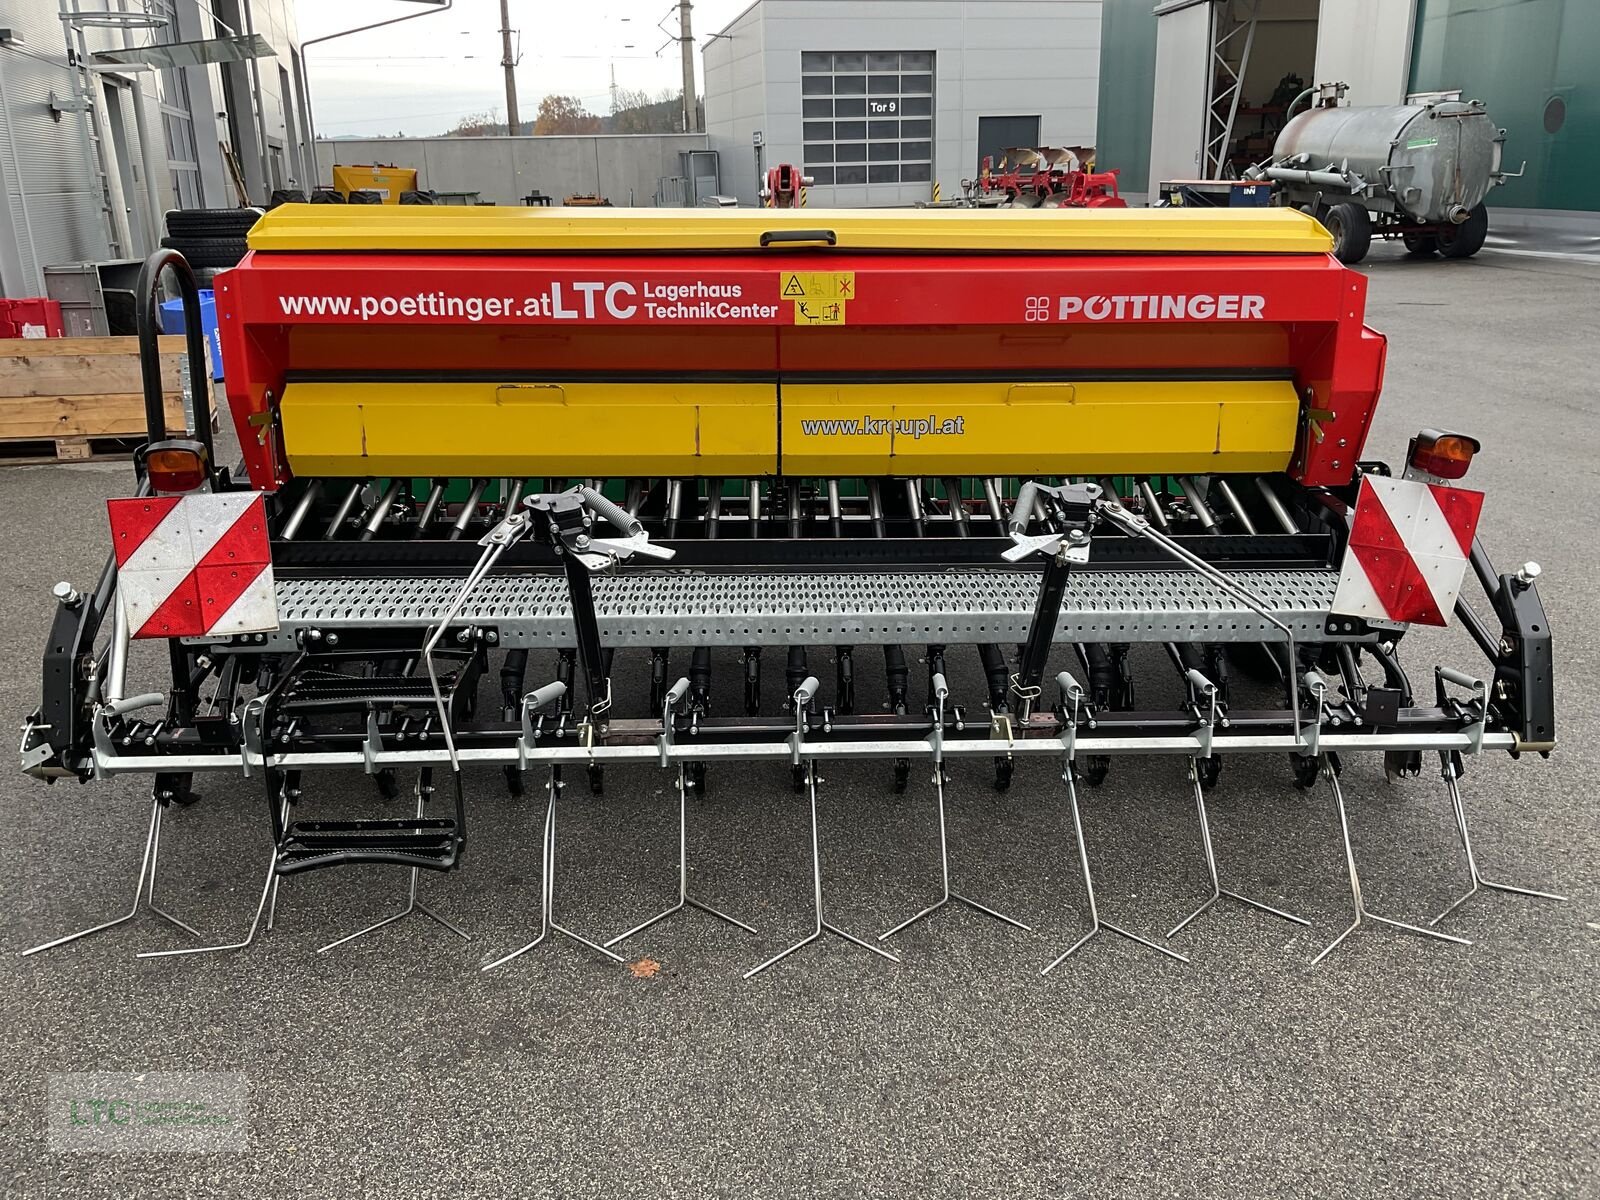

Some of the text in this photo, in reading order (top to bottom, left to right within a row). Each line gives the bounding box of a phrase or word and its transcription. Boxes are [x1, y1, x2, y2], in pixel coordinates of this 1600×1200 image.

[870, 102, 896, 113] Tor 9
[551, 282, 638, 319] LTC
[643, 281, 742, 302] Lagerhaus
[279, 292, 552, 322] www.poettinger.at
[644, 302, 779, 319] TechnikCenter
[1058, 294, 1266, 320] PÖTTINGER
[801, 415, 965, 439] www.kreupl.at
